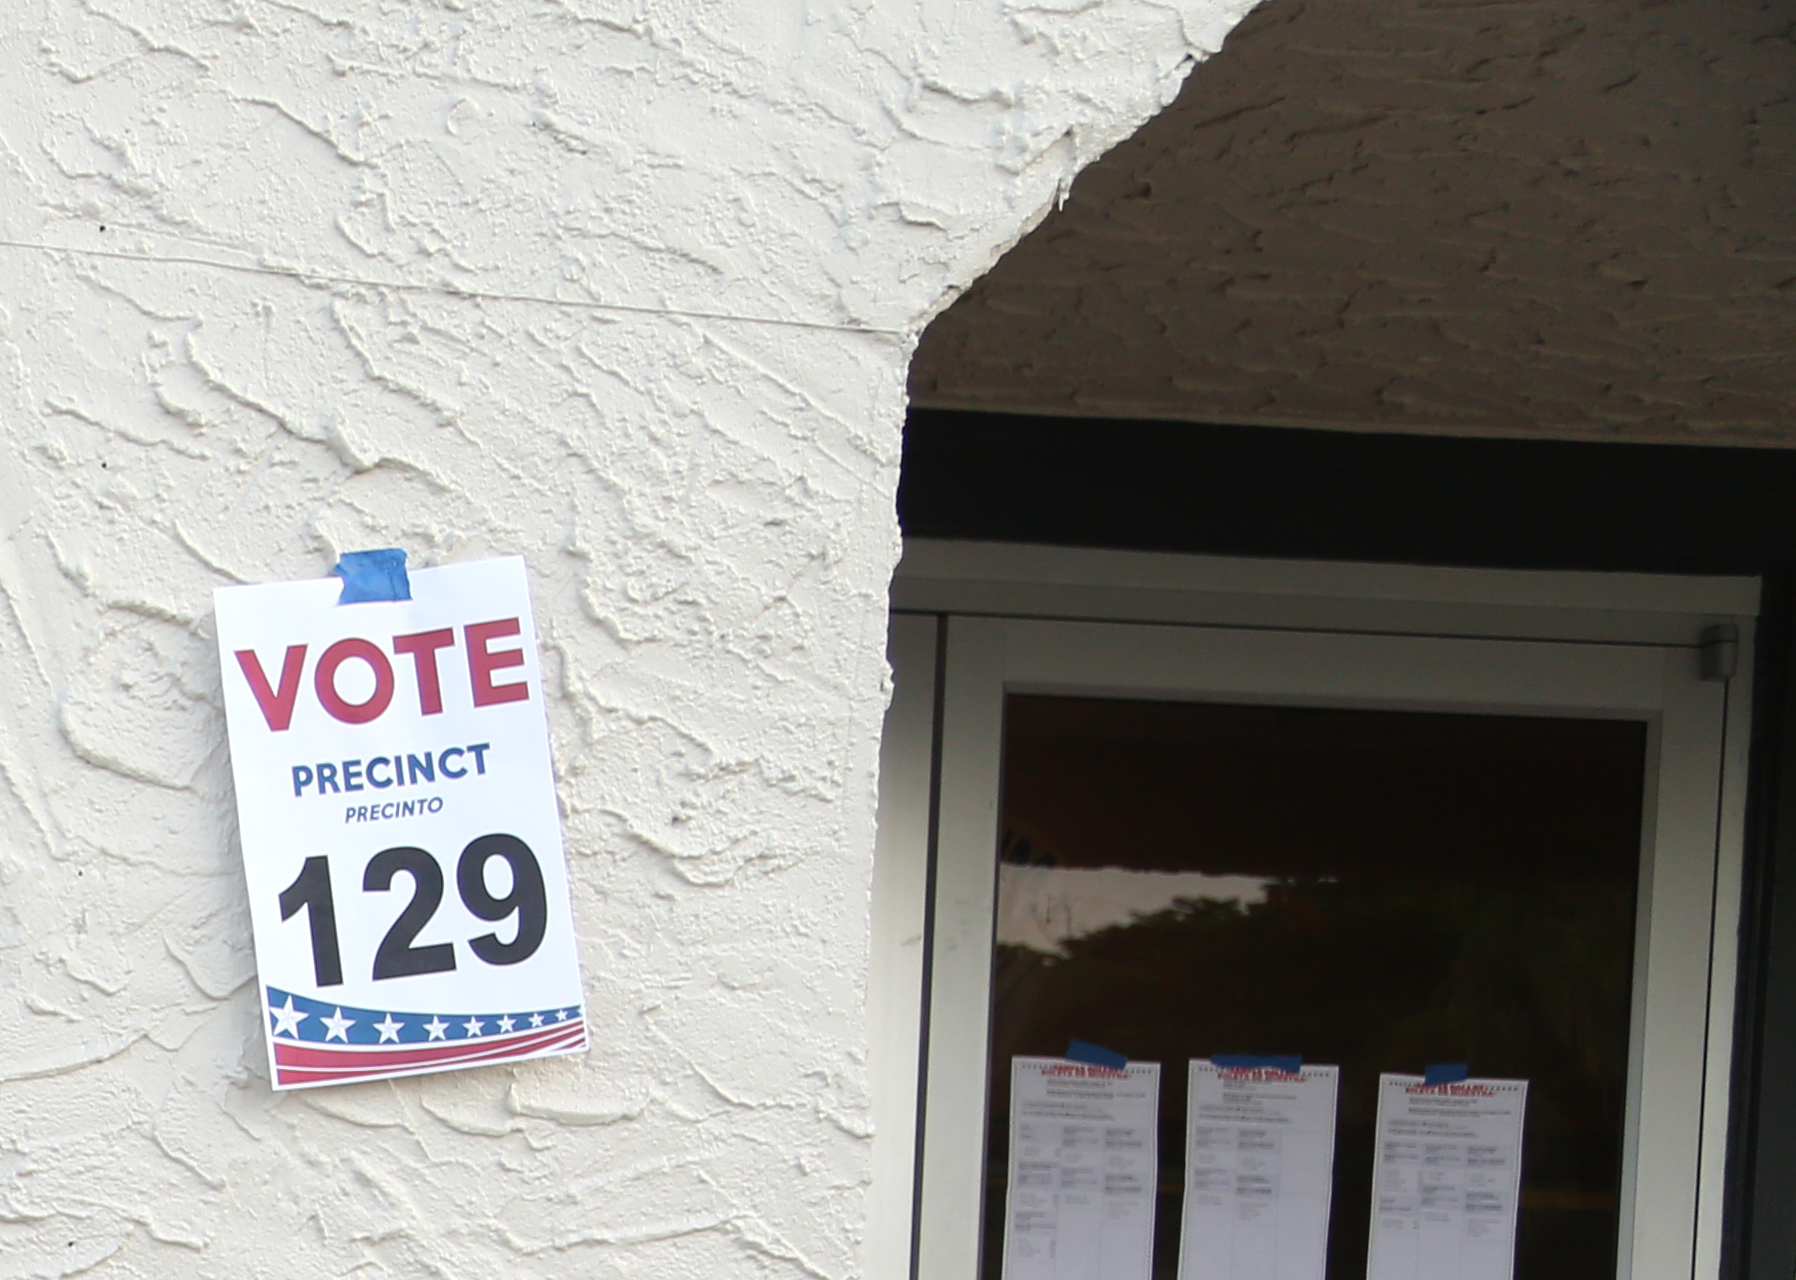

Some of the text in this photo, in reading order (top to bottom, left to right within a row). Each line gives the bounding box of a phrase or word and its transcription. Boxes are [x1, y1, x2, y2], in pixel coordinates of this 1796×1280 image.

[233, 616, 530, 733] VOTE
[291, 742, 491, 798] PRECINCT
[344, 796, 444, 824] PRECINTO
[277, 832, 548, 989] 129
